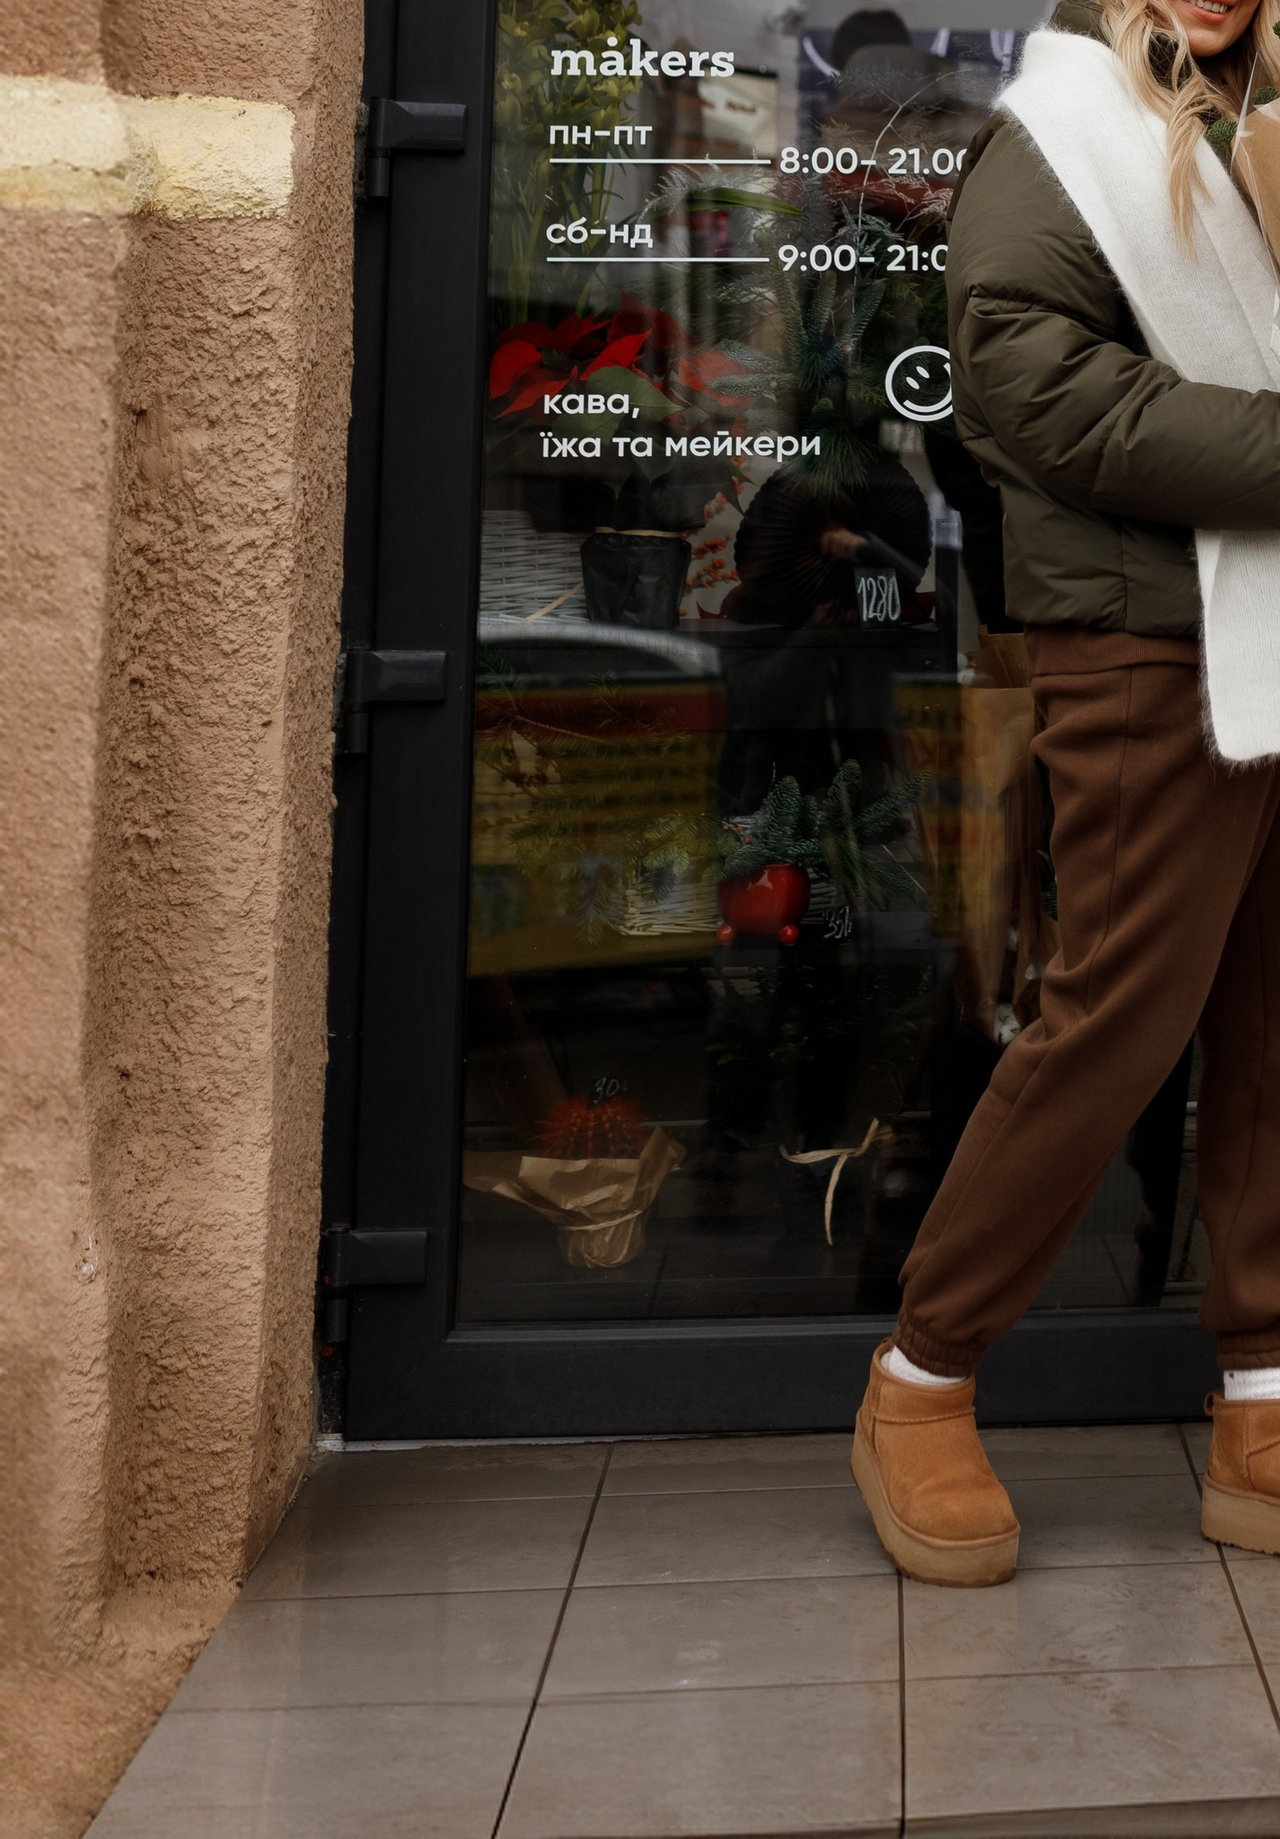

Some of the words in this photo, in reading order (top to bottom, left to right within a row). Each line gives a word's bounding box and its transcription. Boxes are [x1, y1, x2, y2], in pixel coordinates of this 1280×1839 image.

[886, 244, 949, 271] 21:0
[543, 393, 640, 419] кава,
[540, 432, 602, 458] їжа
[612, 436, 653, 457] та
[665, 430, 821, 463] мейкери
[857, 575, 902, 622] 1280
